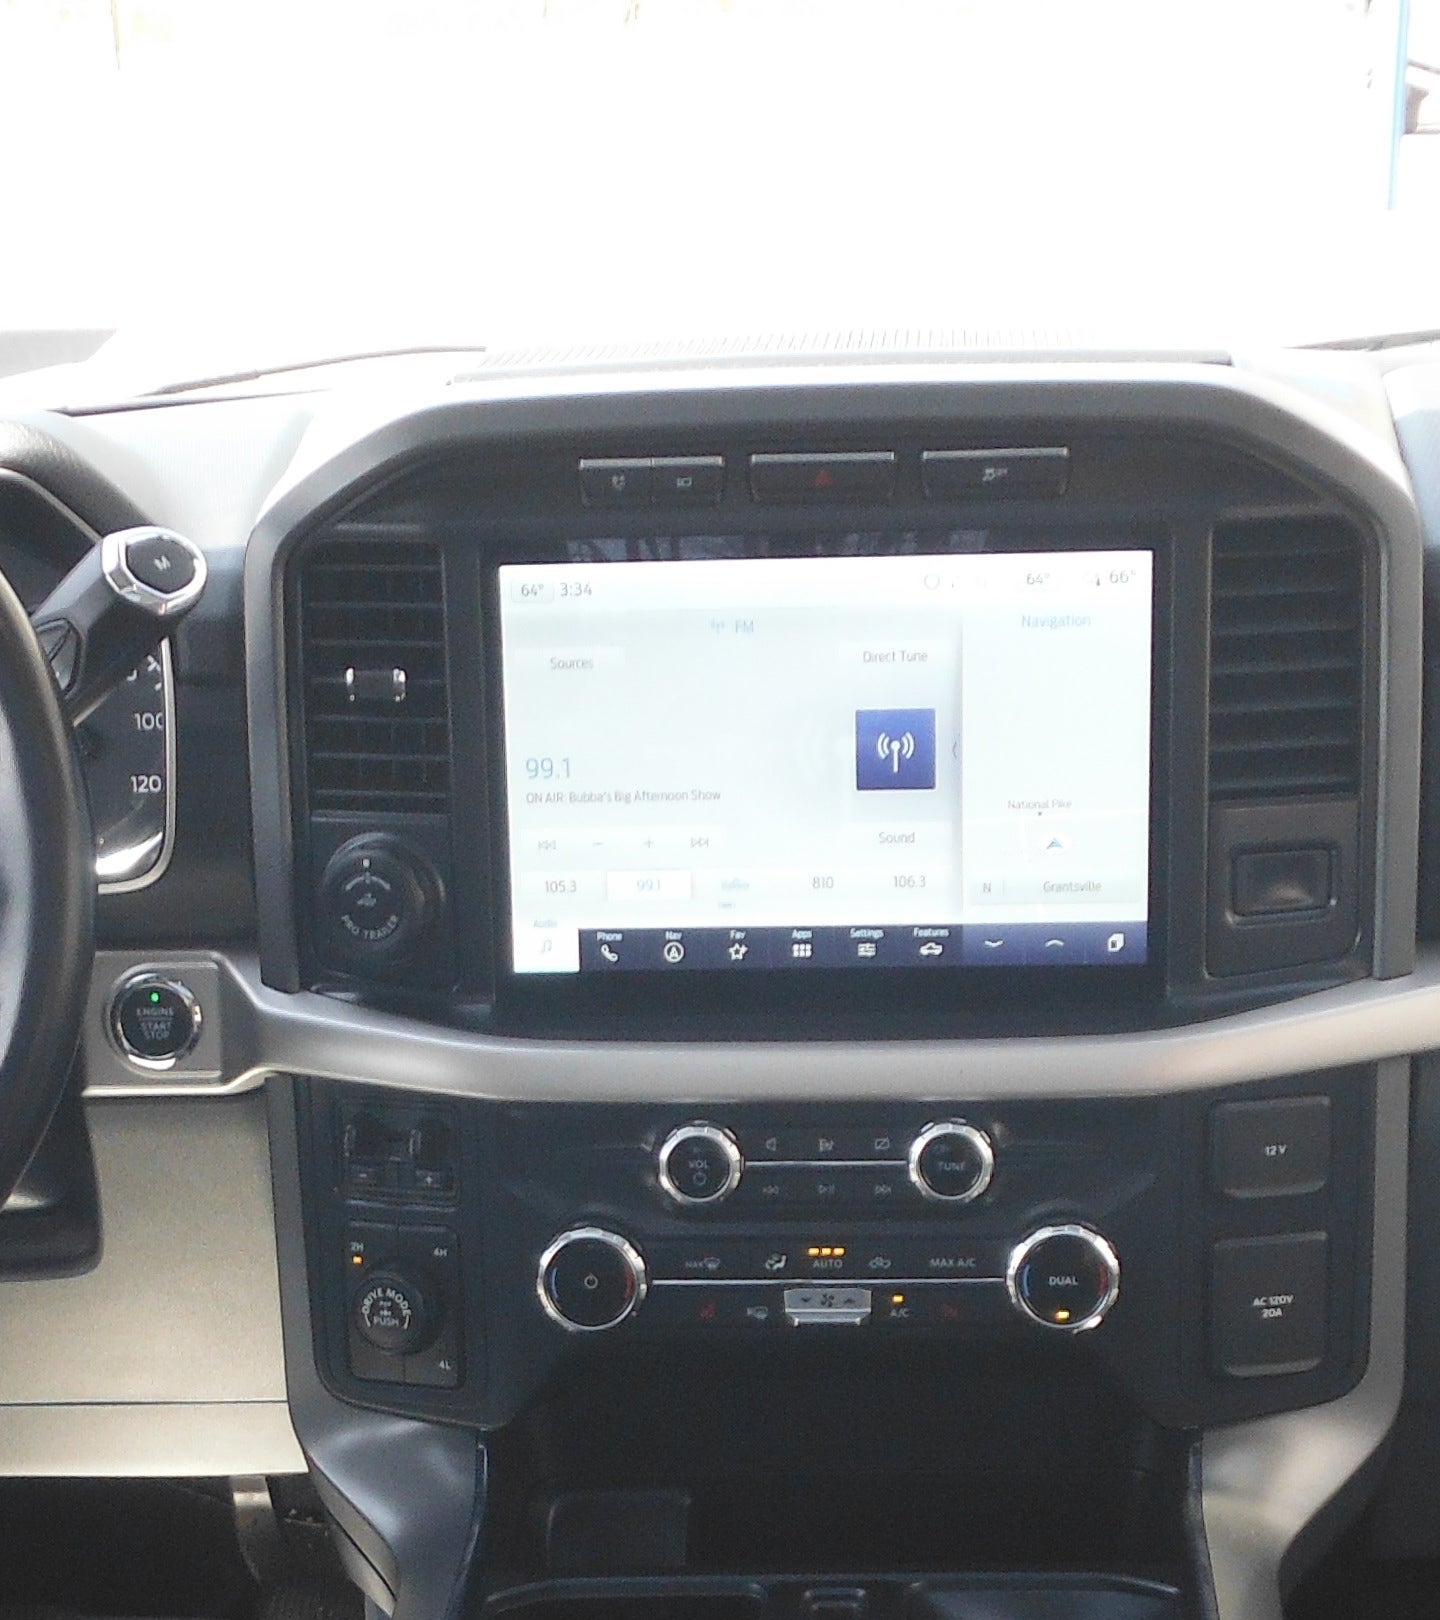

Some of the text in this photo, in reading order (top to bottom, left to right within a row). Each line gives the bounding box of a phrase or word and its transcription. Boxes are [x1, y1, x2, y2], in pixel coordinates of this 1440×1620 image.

[559, 581, 592, 597] 3:34
[735, 620, 754, 633] FM
[1021, 614, 1092, 629] Navigation
[863, 649, 928, 663] Direct Tune
[550, 656, 594, 671] Sources
[525, 757, 571, 779] 99.1
[131, 775, 163, 793] 120
[526, 792, 543, 804] ON
[614, 790, 632, 804] Big
[634, 790, 689, 802] Afternoon
[691, 788, 722, 801] Show
[878, 832, 915, 844] Sound
[545, 879, 577, 893] 105.3
[812, 876, 834, 889] 810
[893, 875, 926, 888] 106.3
[982, 882, 991, 893] N
[1042, 879, 1102, 893] Grantsville
[596, 931, 623, 942] Phone
[665, 931, 682, 940] Nav
[730, 929, 746, 939] Fav
[791, 929, 812, 941] Apps
[850, 927, 884, 940] Settings
[913, 927, 949, 938] Features
[812, 1259, 843, 1270] AUTO
[1048, 1276, 1079, 1287] DUAL
[361, 1287, 412, 1317] DRIVE MODE
[890, 1307, 910, 1319] A/C
